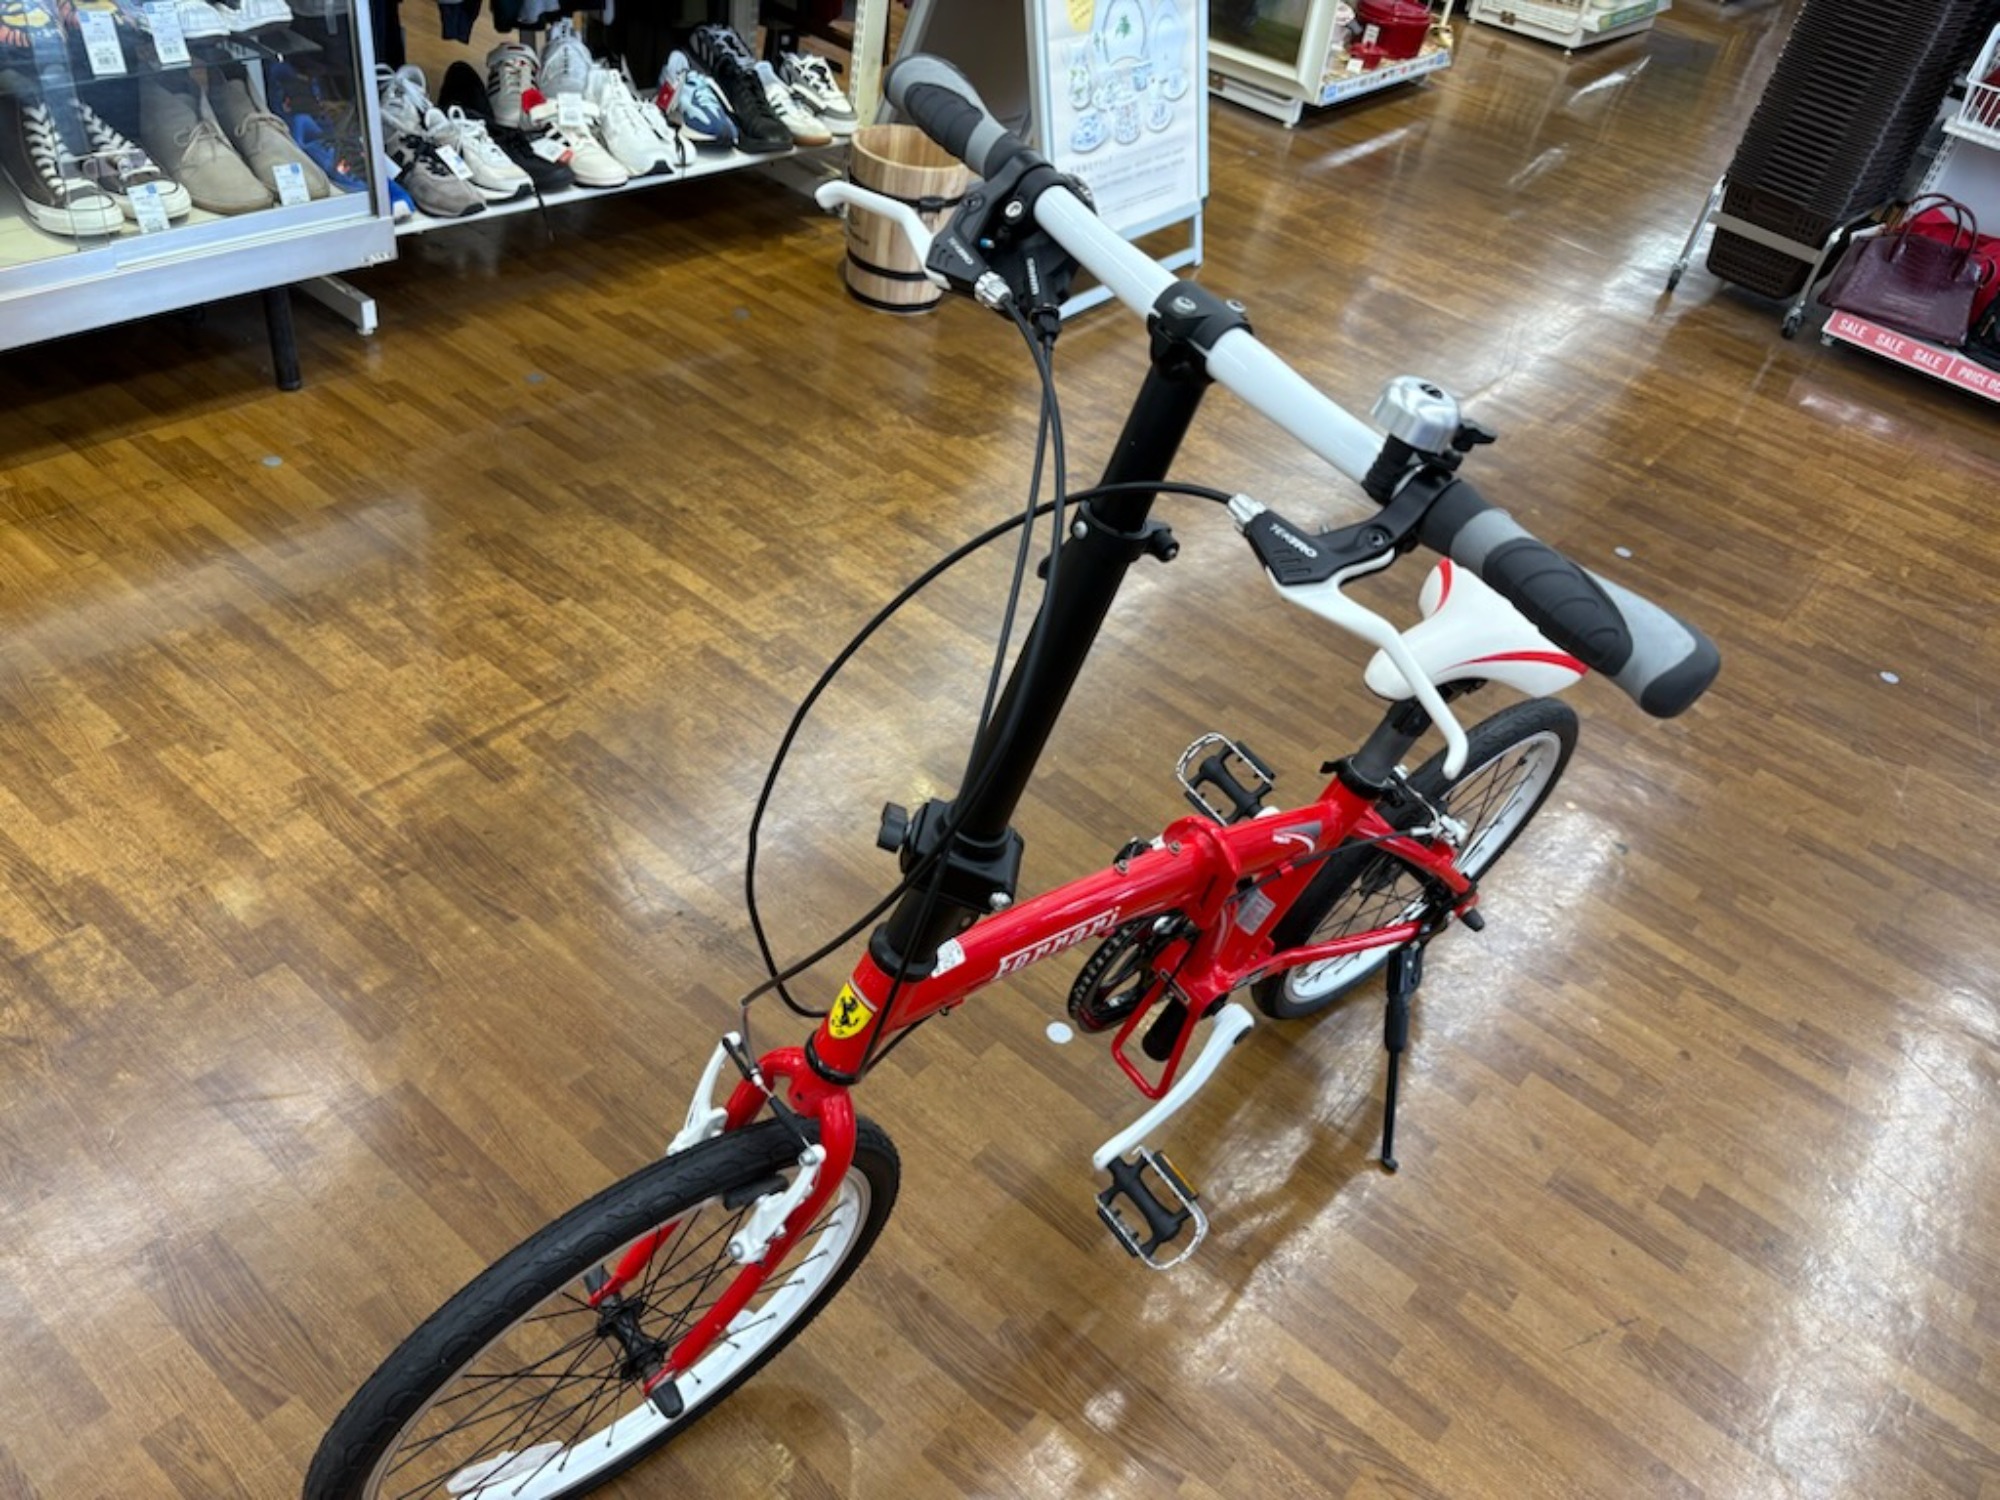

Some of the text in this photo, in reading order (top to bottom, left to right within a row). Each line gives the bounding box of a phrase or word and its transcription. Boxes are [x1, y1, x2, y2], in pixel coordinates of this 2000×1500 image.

[1839, 318, 1867, 338] SALE
[1875, 334, 1905, 352] SALE
[1912, 349, 1942, 369] SALE
[1958, 366, 1988, 386] PRICE
